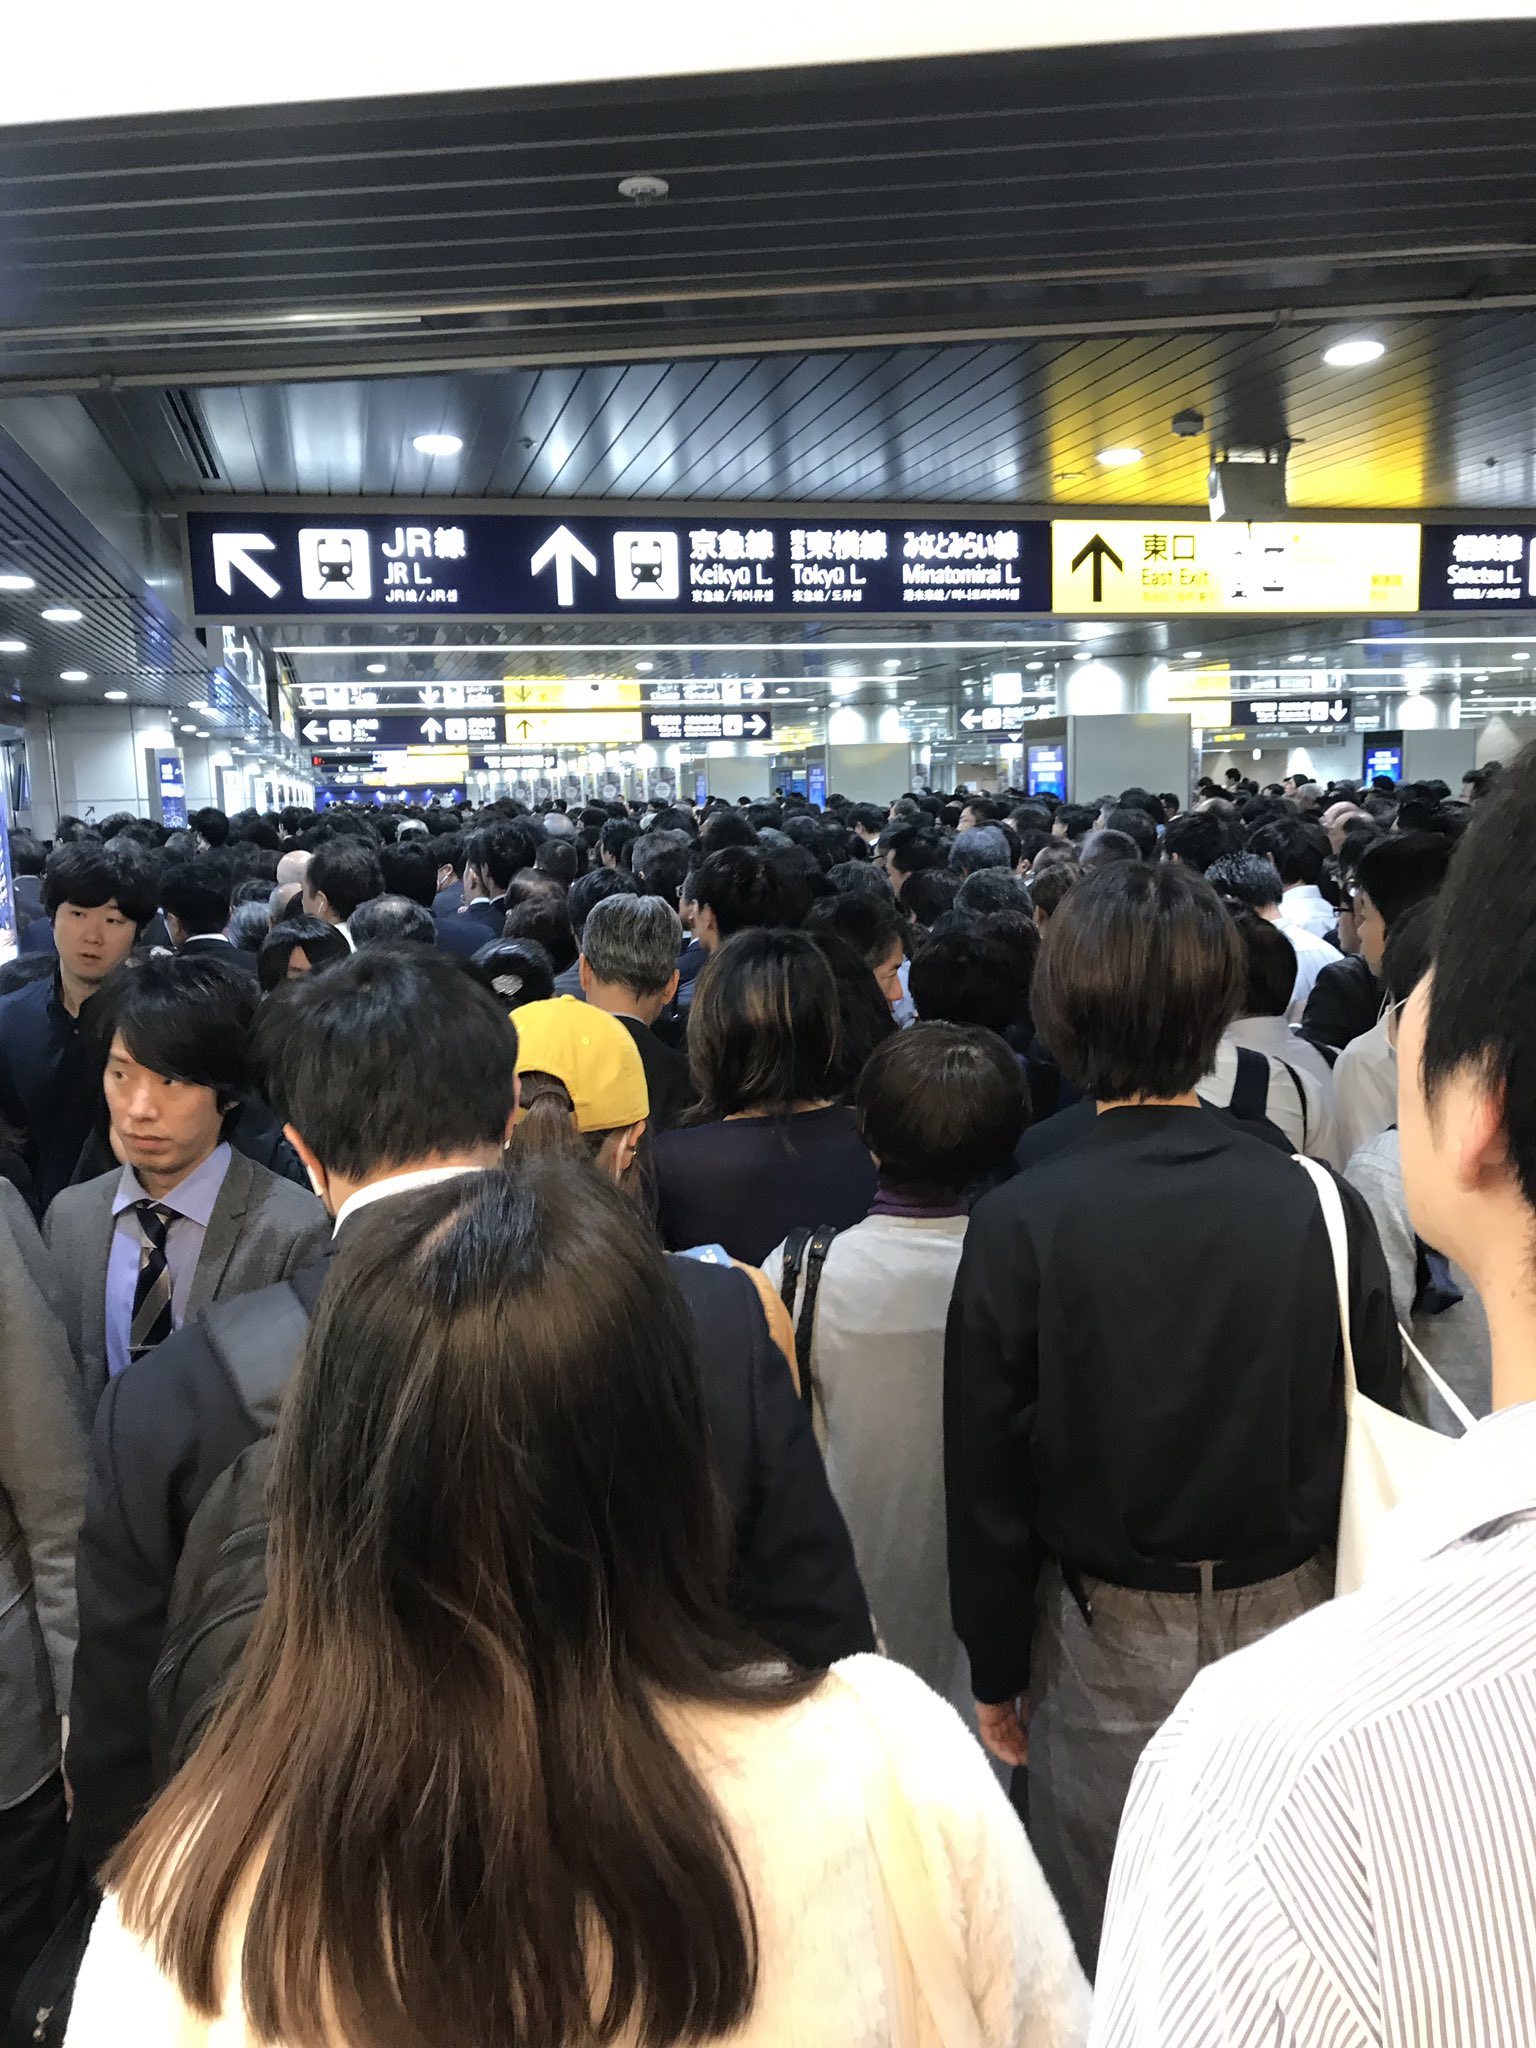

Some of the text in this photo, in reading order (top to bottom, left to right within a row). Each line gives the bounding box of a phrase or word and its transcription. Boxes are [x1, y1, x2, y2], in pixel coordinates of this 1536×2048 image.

[1142, 533, 1195, 560] 東口
[384, 562, 408, 584] JR
[903, 564, 1001, 583] Minatomirai
[1142, 568, 1173, 585] East
